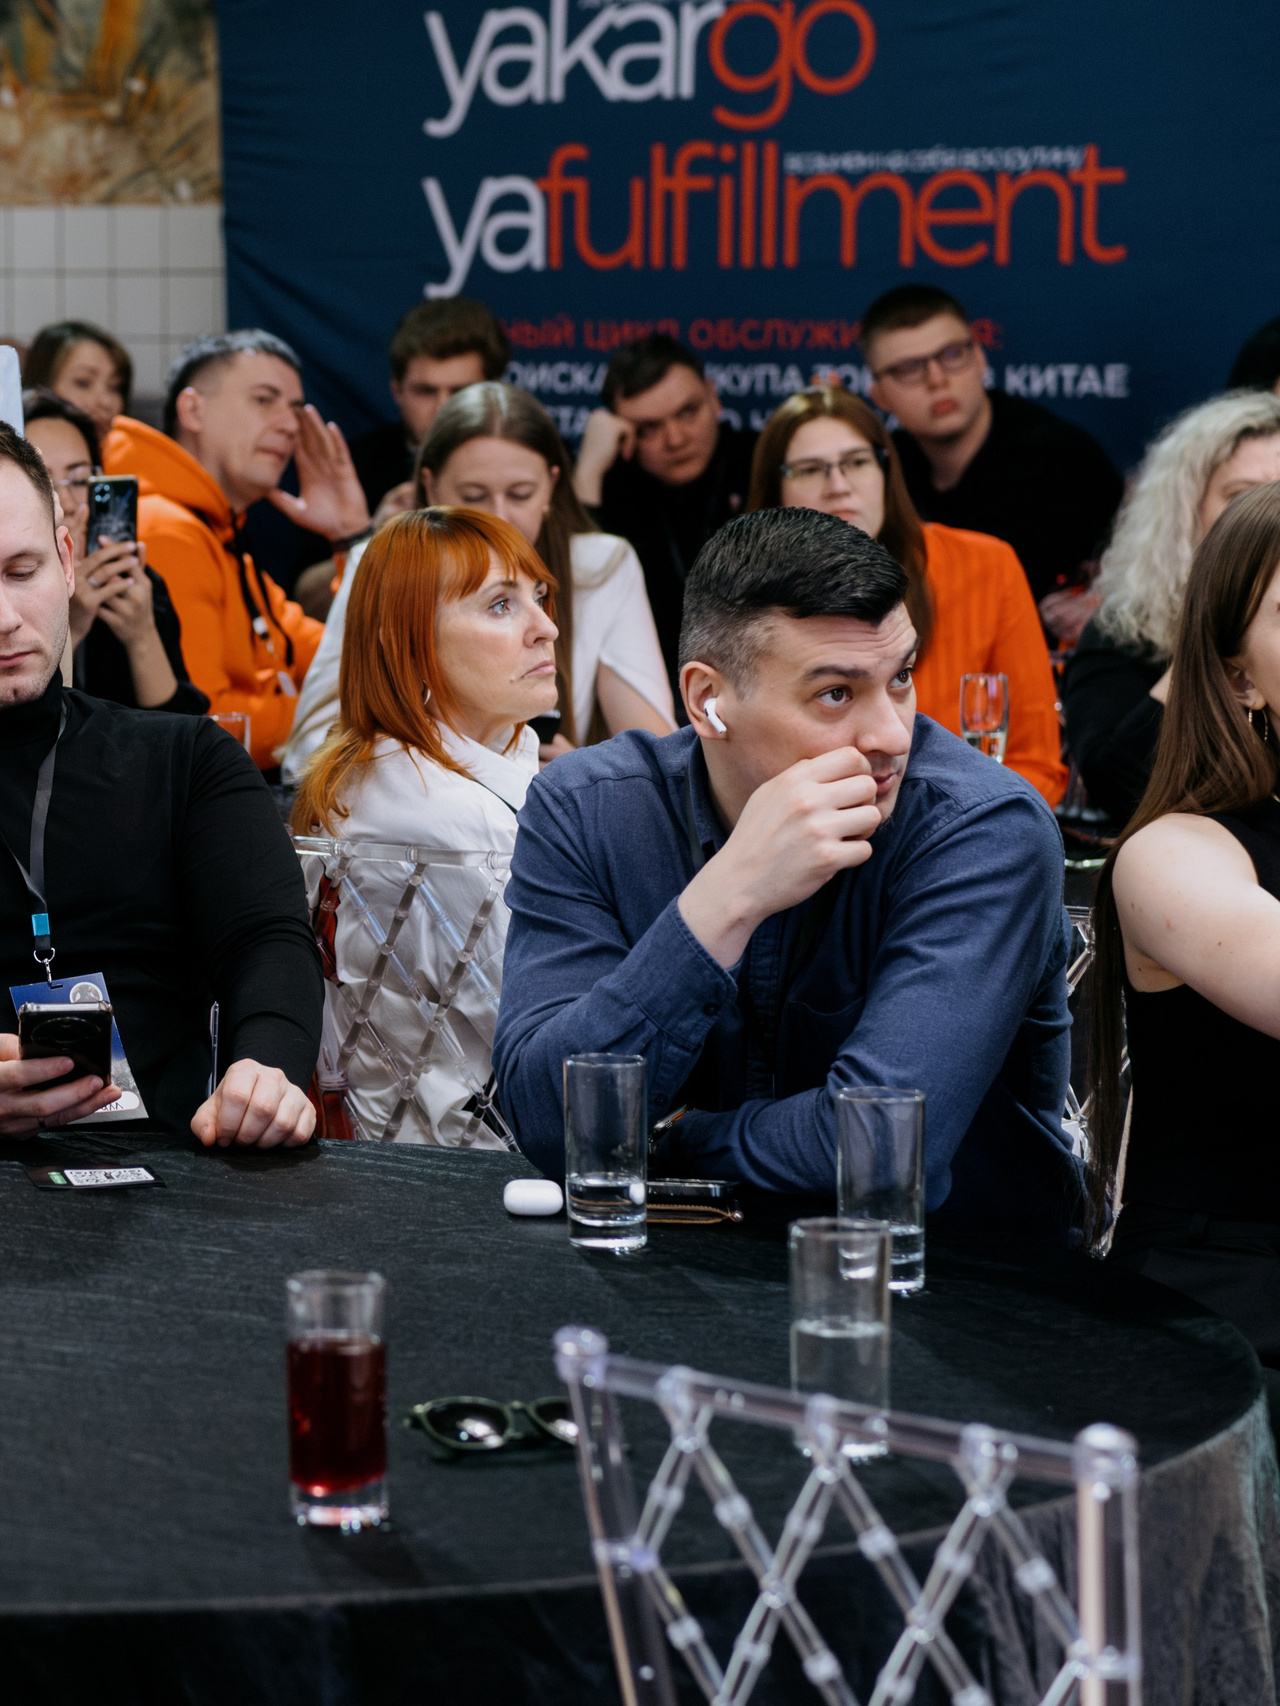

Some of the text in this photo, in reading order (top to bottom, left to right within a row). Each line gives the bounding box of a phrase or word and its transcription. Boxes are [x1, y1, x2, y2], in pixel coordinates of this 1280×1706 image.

[422, 0, 877, 137] yakargo
[423, 141, 1127, 300] yafulfillment
[1004, 362, 1130, 398] КИТАЕ
